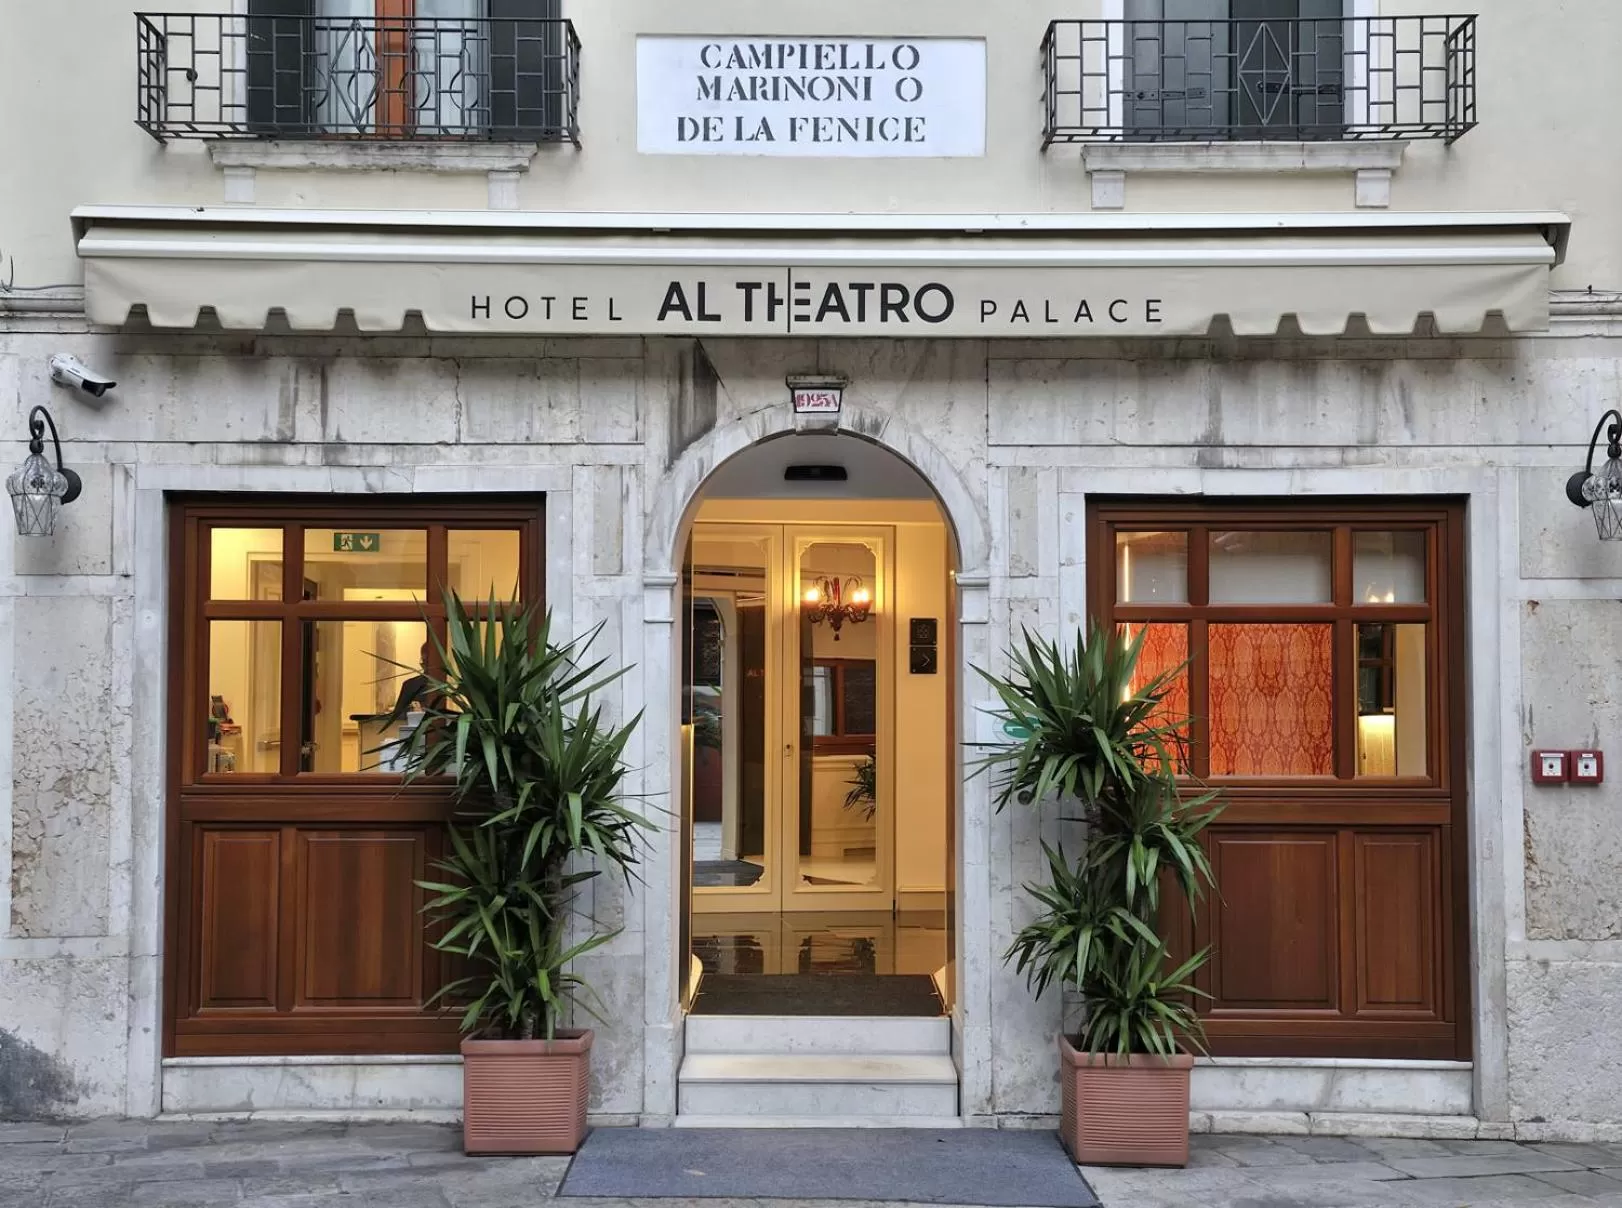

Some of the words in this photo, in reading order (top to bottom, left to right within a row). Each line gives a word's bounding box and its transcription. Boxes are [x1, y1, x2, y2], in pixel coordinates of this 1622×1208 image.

[700, 43, 920, 71] CAMPIELLO
[697, 75, 872, 102] MARINONI
[895, 77, 923, 102] O
[677, 116, 724, 142] DE
[735, 116, 775, 142] LA
[788, 116, 925, 142] FENICE
[471, 295, 623, 321] HOTEL
[657, 281, 722, 322] AL
[735, 274, 955, 327] THEATRO
[980, 299, 1162, 323] PALACE
